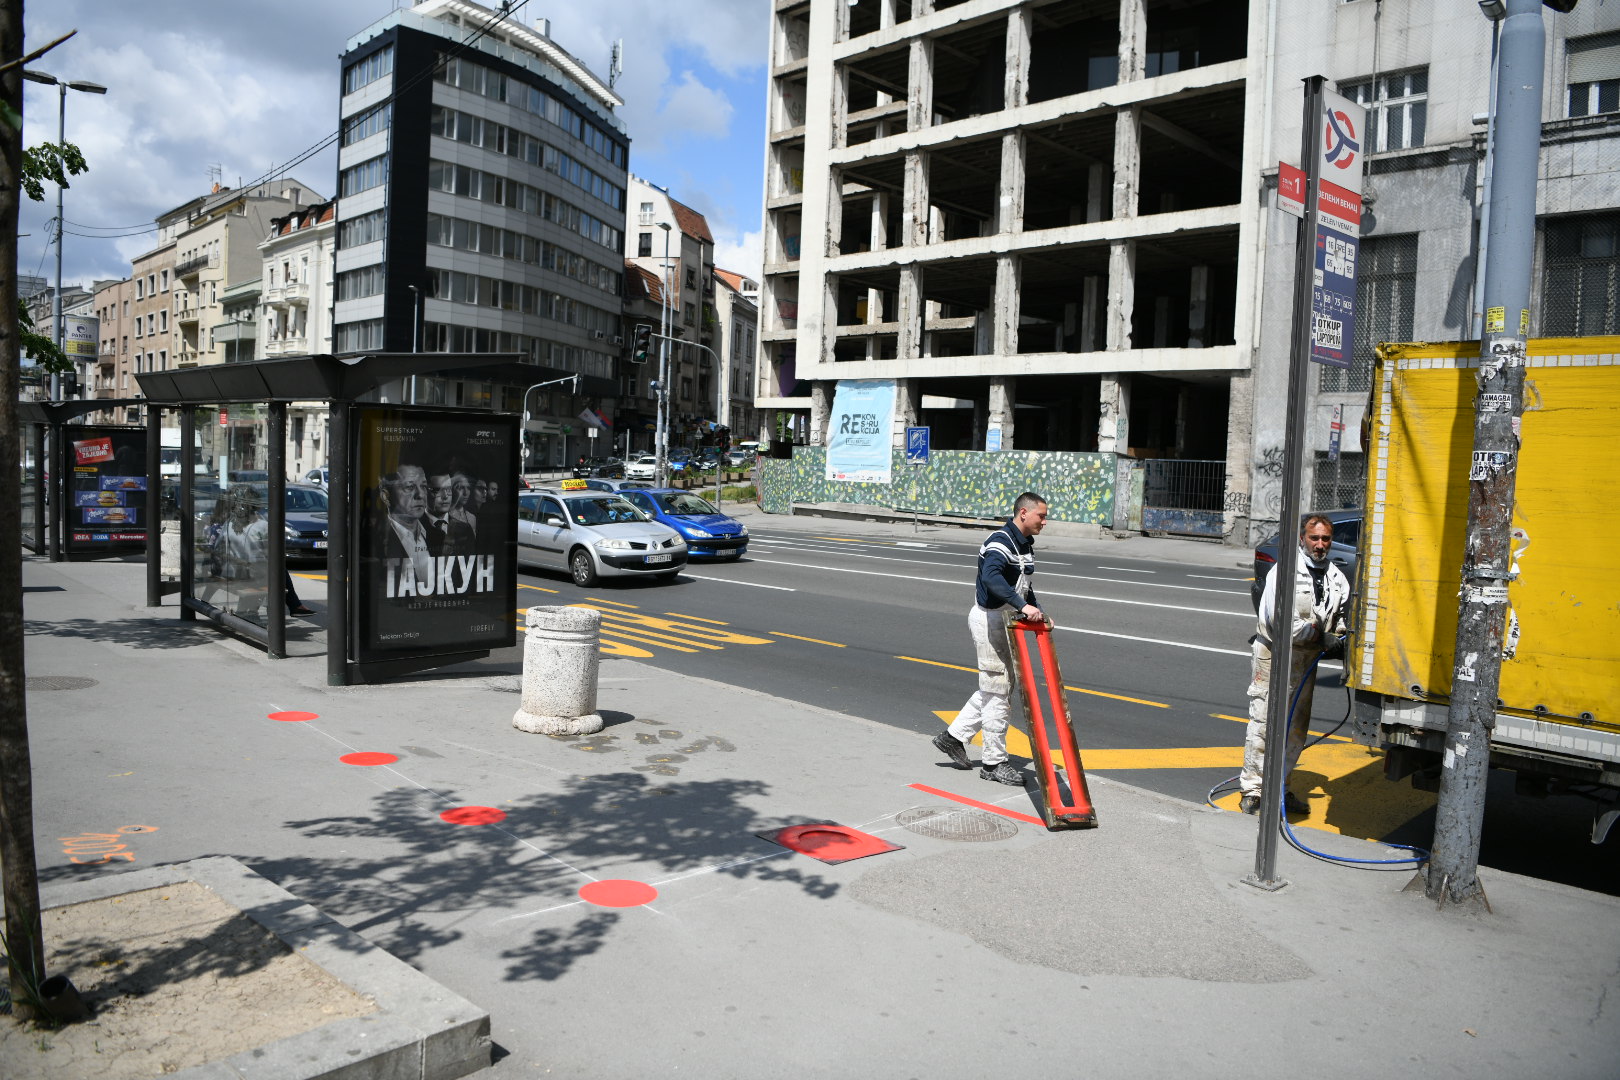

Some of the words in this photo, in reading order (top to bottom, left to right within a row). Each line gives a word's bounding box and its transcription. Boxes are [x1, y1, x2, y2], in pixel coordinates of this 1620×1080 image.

[1294, 177, 1300, 195] 1
[1318, 190, 1340, 205] ЗЕЛЕНИ
[1340, 198, 1358, 214] ВЕНАЦ
[1314, 291, 1321, 301] 15
[1334, 297, 1341, 307] 75
[1317, 319, 1341, 331] OTKUP
[840, 414, 861, 434] RE
[470, 623, 495, 633] FIREFLY
